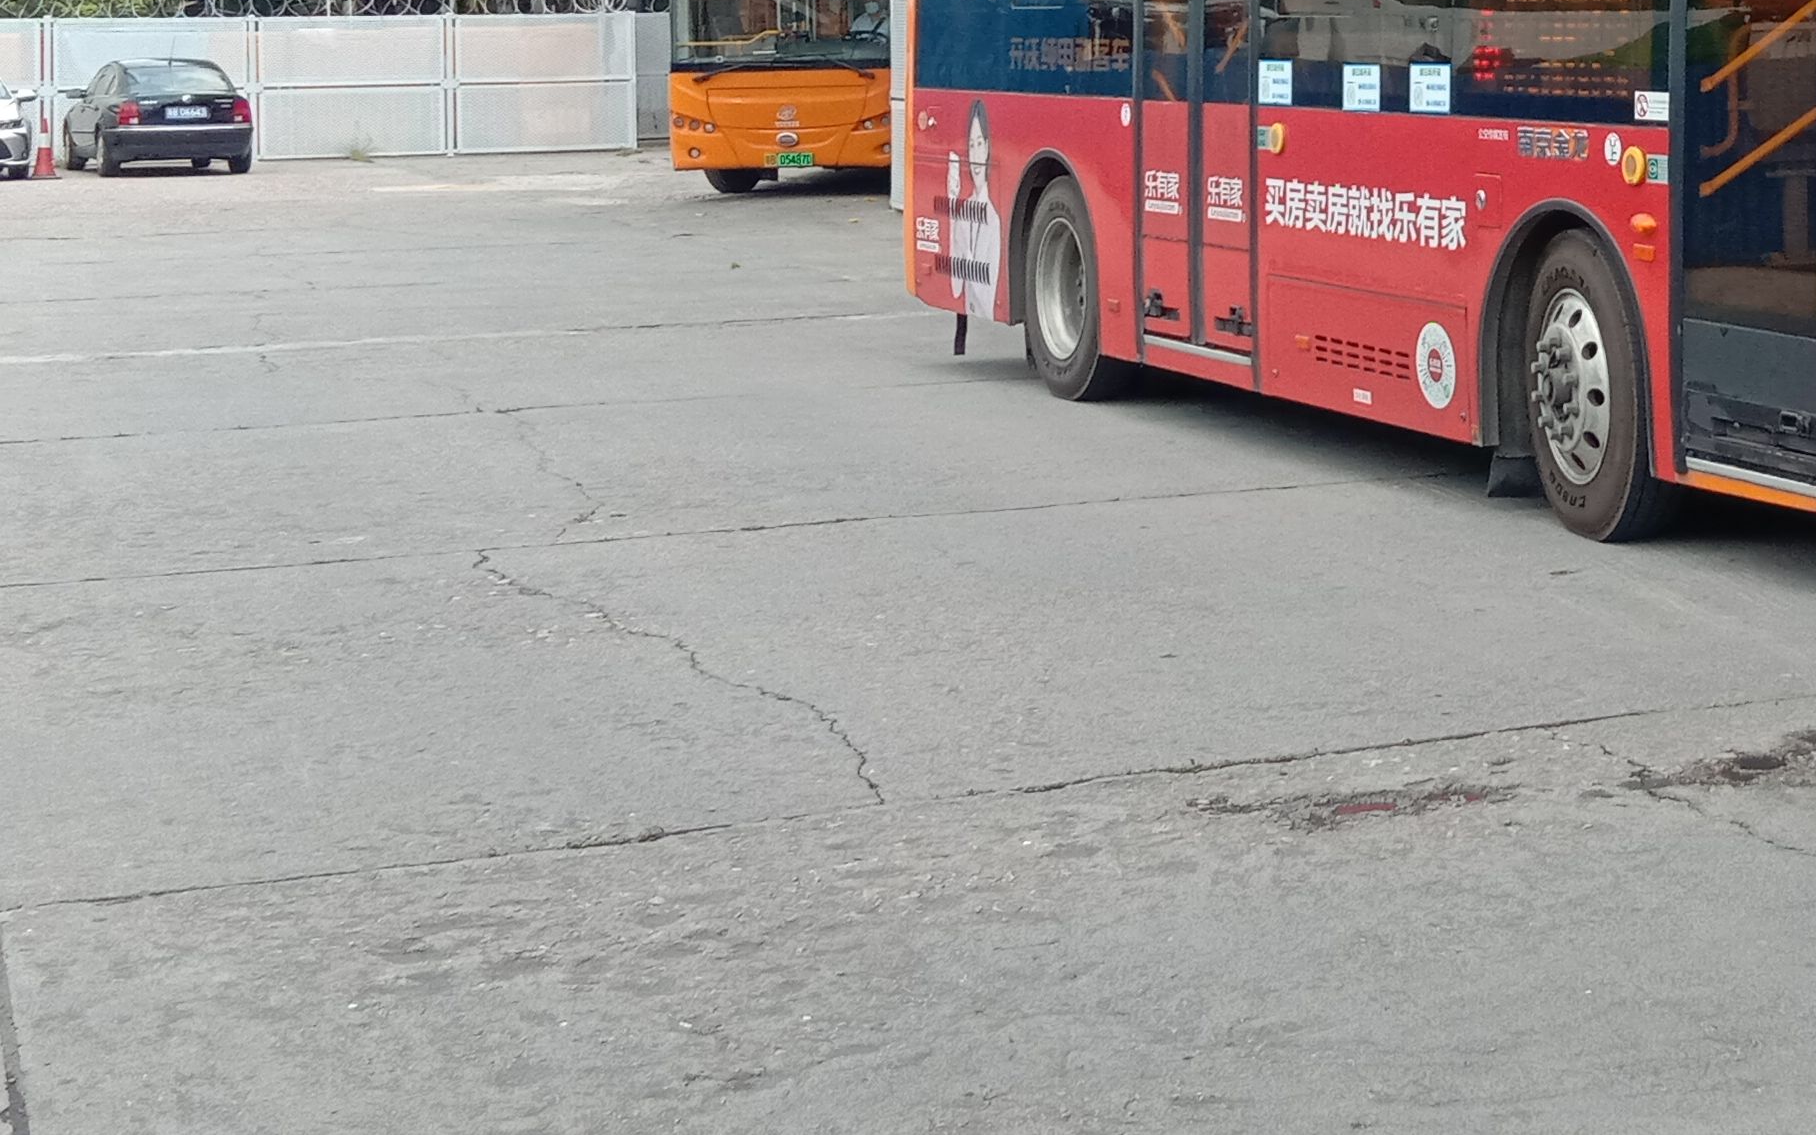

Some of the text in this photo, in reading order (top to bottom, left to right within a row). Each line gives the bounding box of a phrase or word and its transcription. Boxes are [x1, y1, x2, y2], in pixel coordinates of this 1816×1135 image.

[1144, 170, 1179, 199] 乐有家
[1207, 176, 1242, 206] 乐有家
[1264, 177, 1466, 250] 买房卖房就找乐有家
